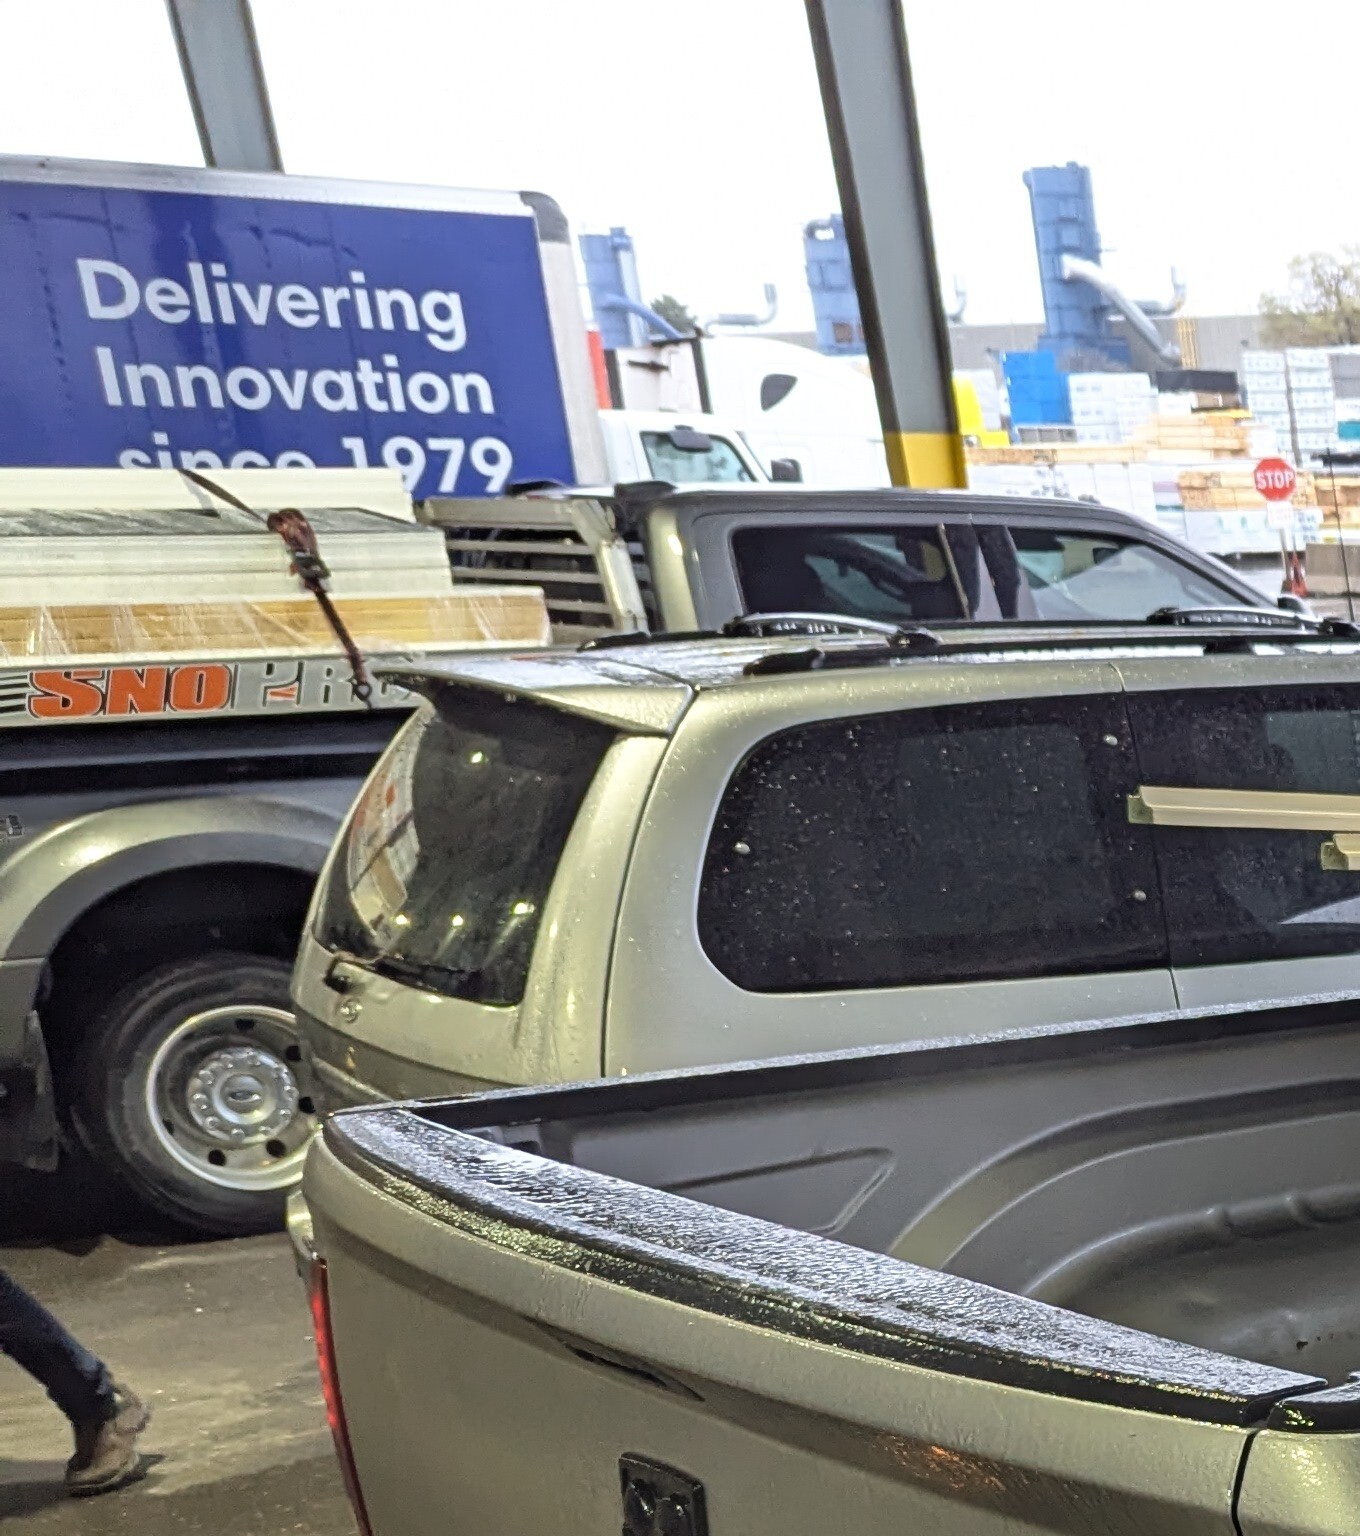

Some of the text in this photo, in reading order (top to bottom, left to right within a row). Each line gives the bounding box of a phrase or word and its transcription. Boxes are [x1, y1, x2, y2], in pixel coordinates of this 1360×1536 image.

[76, 257, 467, 352] Delivering
[95, 346, 495, 415] Innovation
[341, 435, 513, 493] 1979
[1256, 470, 1294, 489] STOP
